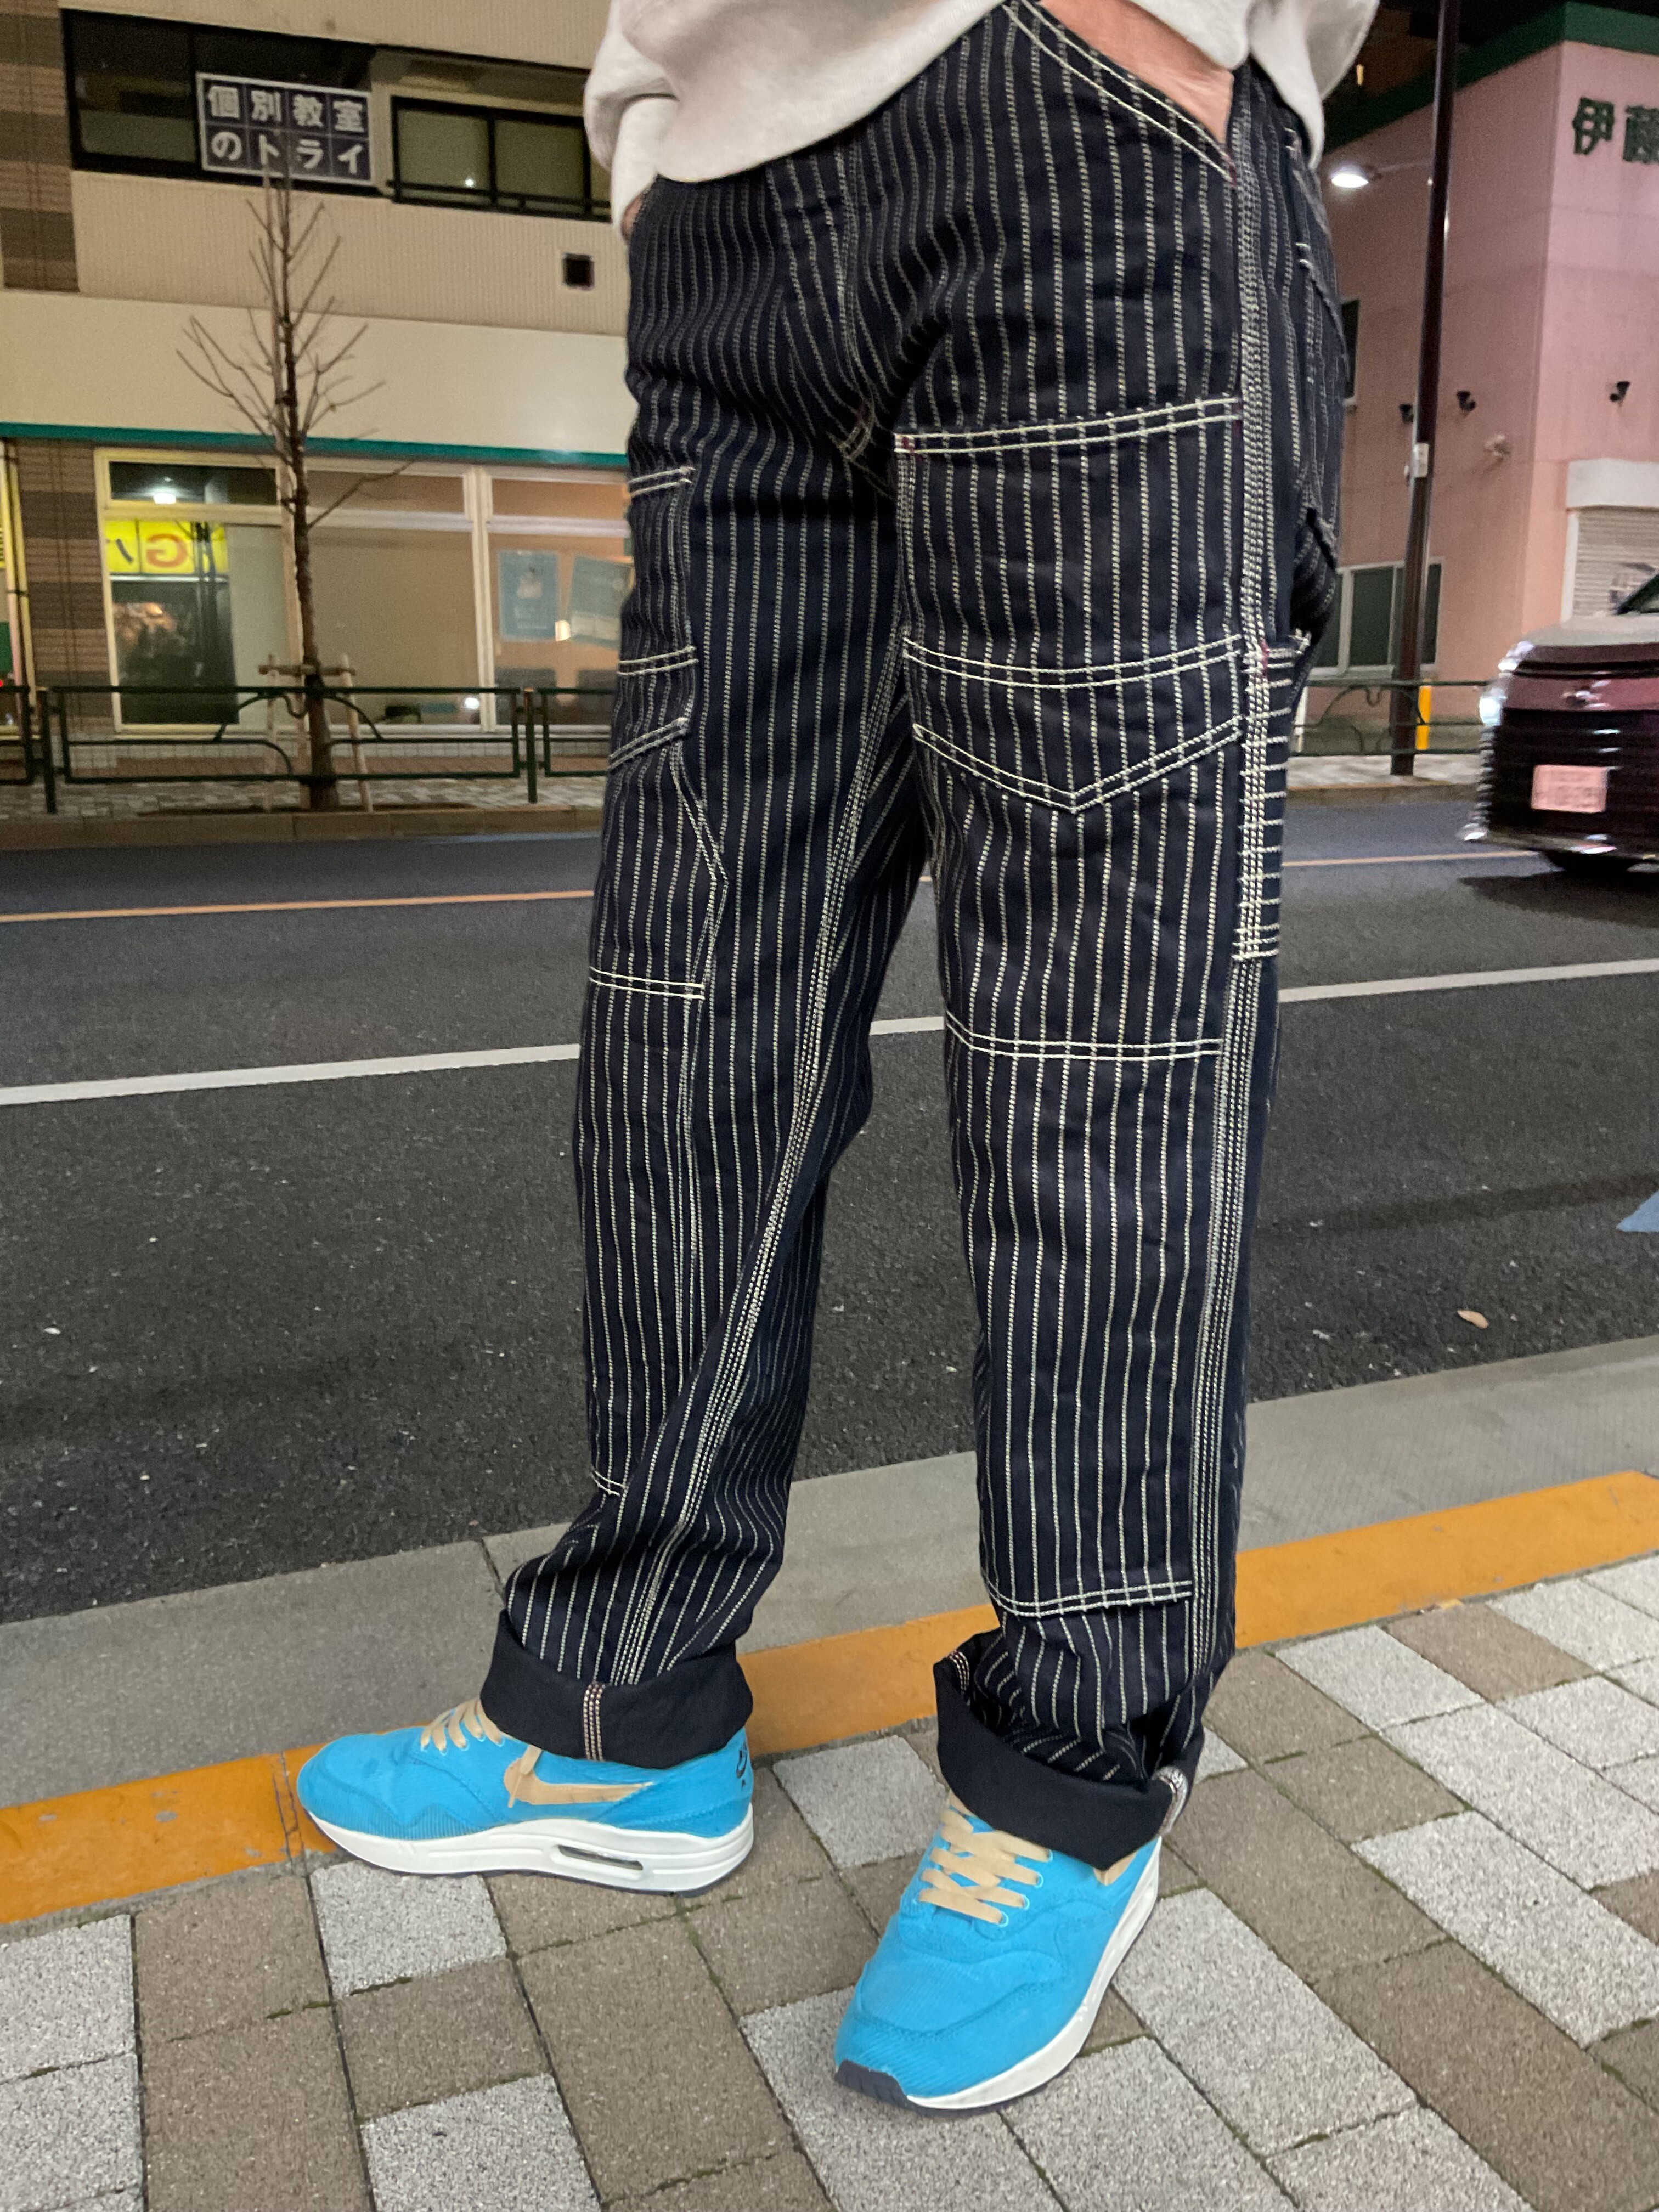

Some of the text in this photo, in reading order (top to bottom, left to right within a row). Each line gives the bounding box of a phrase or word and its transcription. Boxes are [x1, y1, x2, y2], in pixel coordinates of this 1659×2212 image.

[208, 85, 364, 132] 個別教室
[211, 131, 363, 174] のトライ
